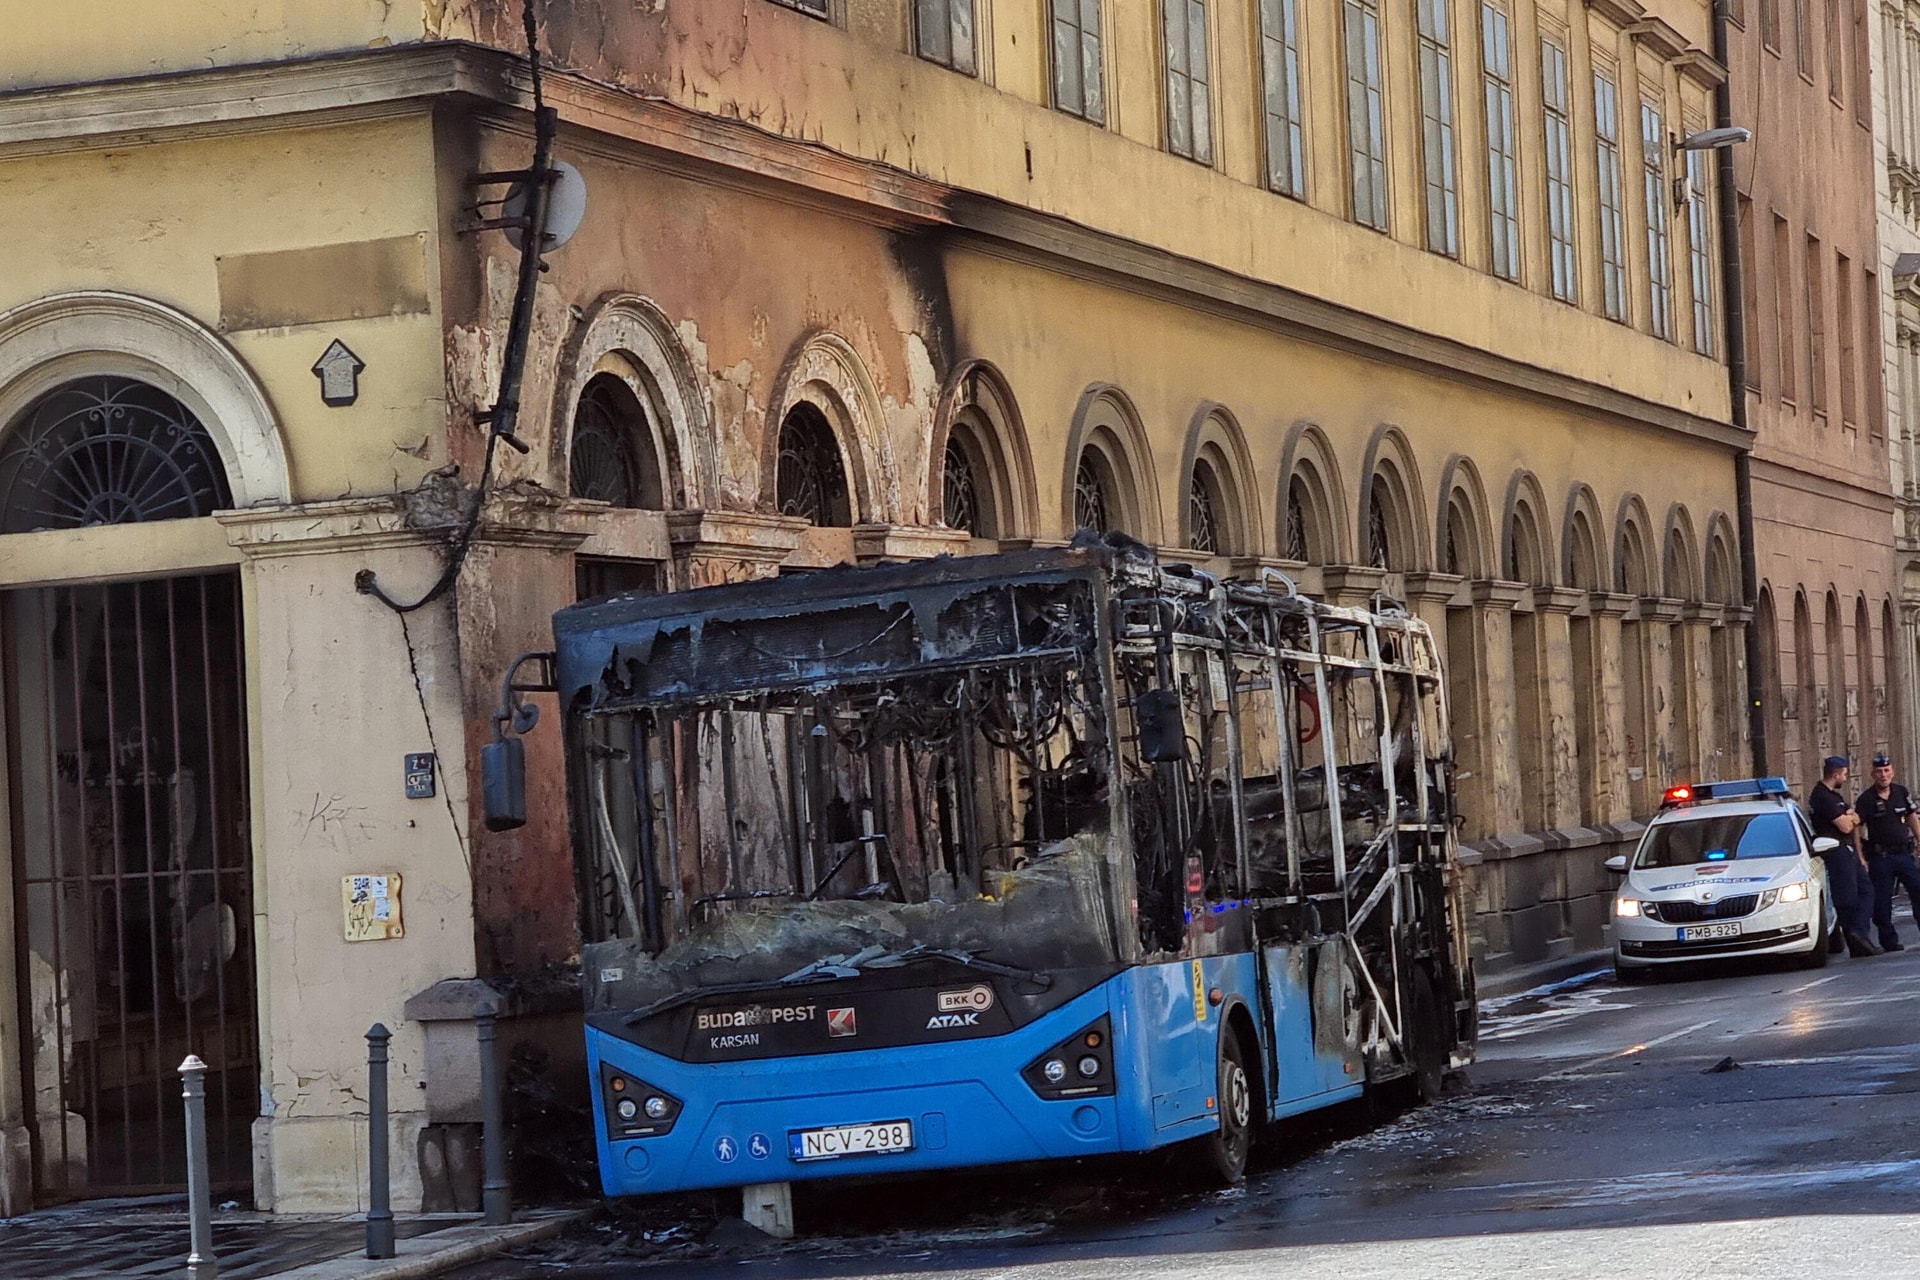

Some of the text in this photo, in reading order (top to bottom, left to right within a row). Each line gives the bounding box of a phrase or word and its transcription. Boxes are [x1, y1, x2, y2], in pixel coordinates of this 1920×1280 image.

[1687, 924, 1738, 939] PMB-925
[945, 995, 969, 1006] BKK
[926, 1012, 980, 1030] ATAK
[711, 1033, 759, 1049] KARSAN
[806, 1126, 904, 1154] NCV-298
